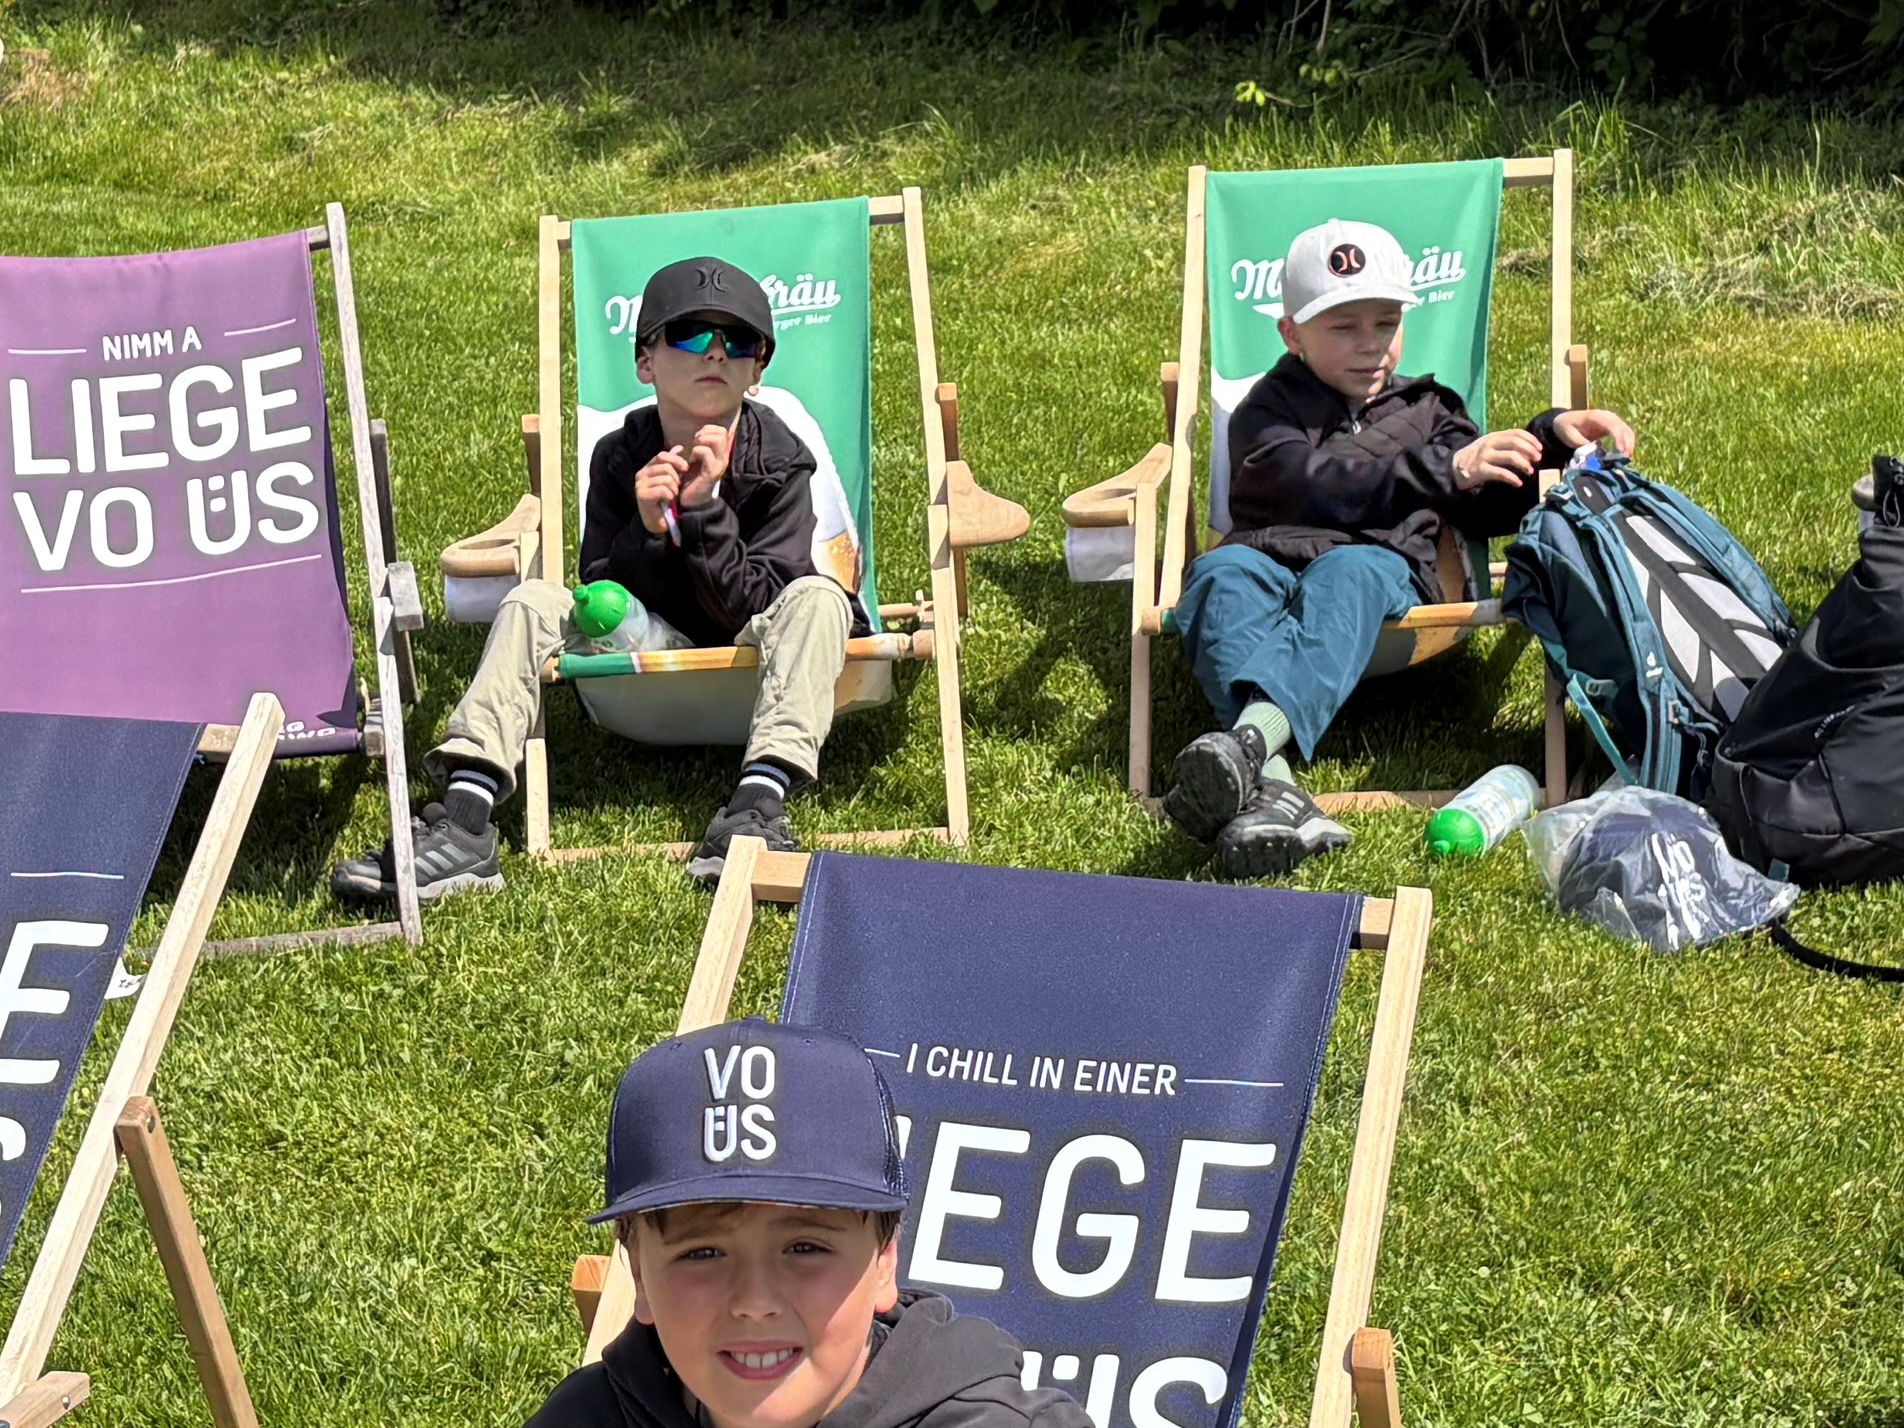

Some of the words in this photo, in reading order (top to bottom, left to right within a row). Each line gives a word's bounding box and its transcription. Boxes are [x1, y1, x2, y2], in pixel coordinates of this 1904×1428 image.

[102, 329, 174, 361] NIMM
[182, 326, 202, 352] A
[9, 346, 312, 475] LIEGE
[13, 486, 154, 571] VO
[186, 461, 320, 556] ÜS
[704, 1045, 775, 1101] VO
[906, 1043, 919, 1073] I
[925, 1046, 1018, 1085] CHILL
[1030, 1056, 1065, 1090] IN
[1074, 1060, 1177, 1095] EINER
[704, 1104, 776, 1162] ÜS
[895, 1115, 1277, 1302] EGE
